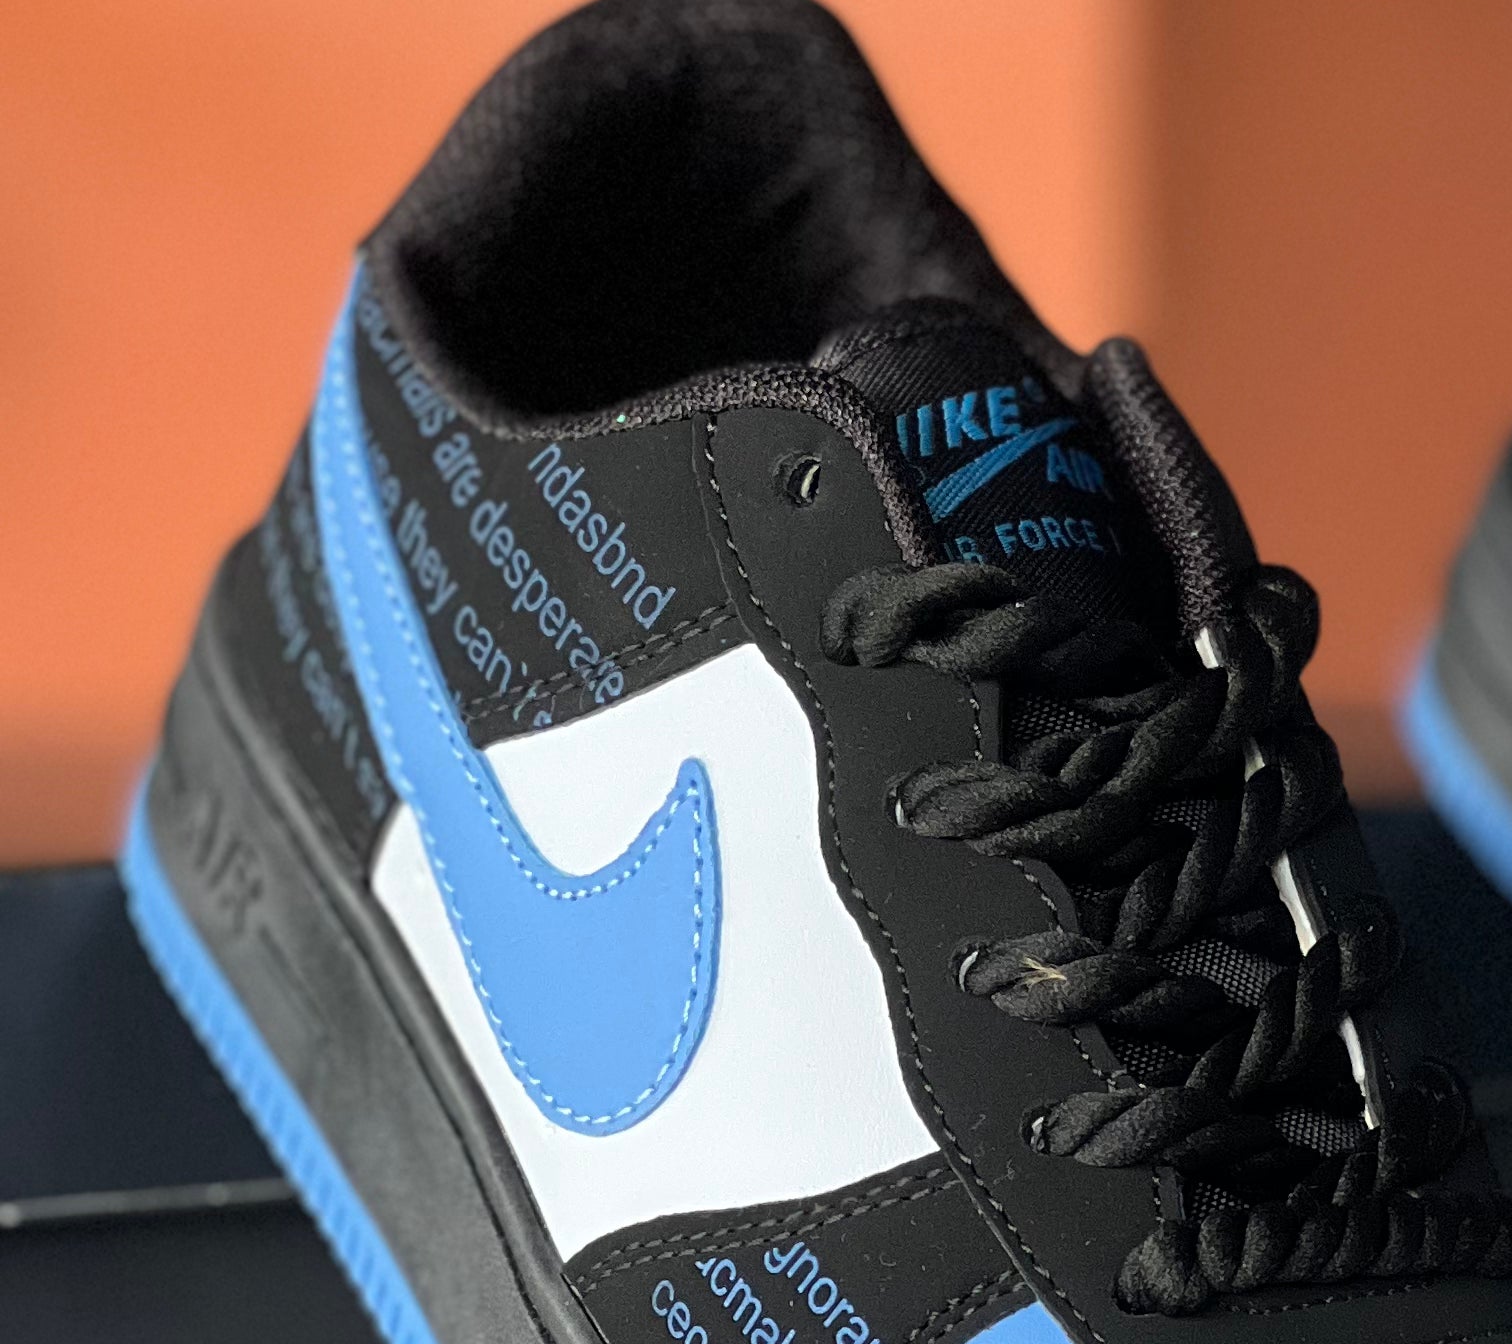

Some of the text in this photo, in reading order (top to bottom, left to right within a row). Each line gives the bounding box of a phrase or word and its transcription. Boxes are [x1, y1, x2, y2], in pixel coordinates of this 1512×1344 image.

[433, 433, 483, 508] are
[397, 498, 460, 615] they
[995, 516, 1105, 557] FORCE
